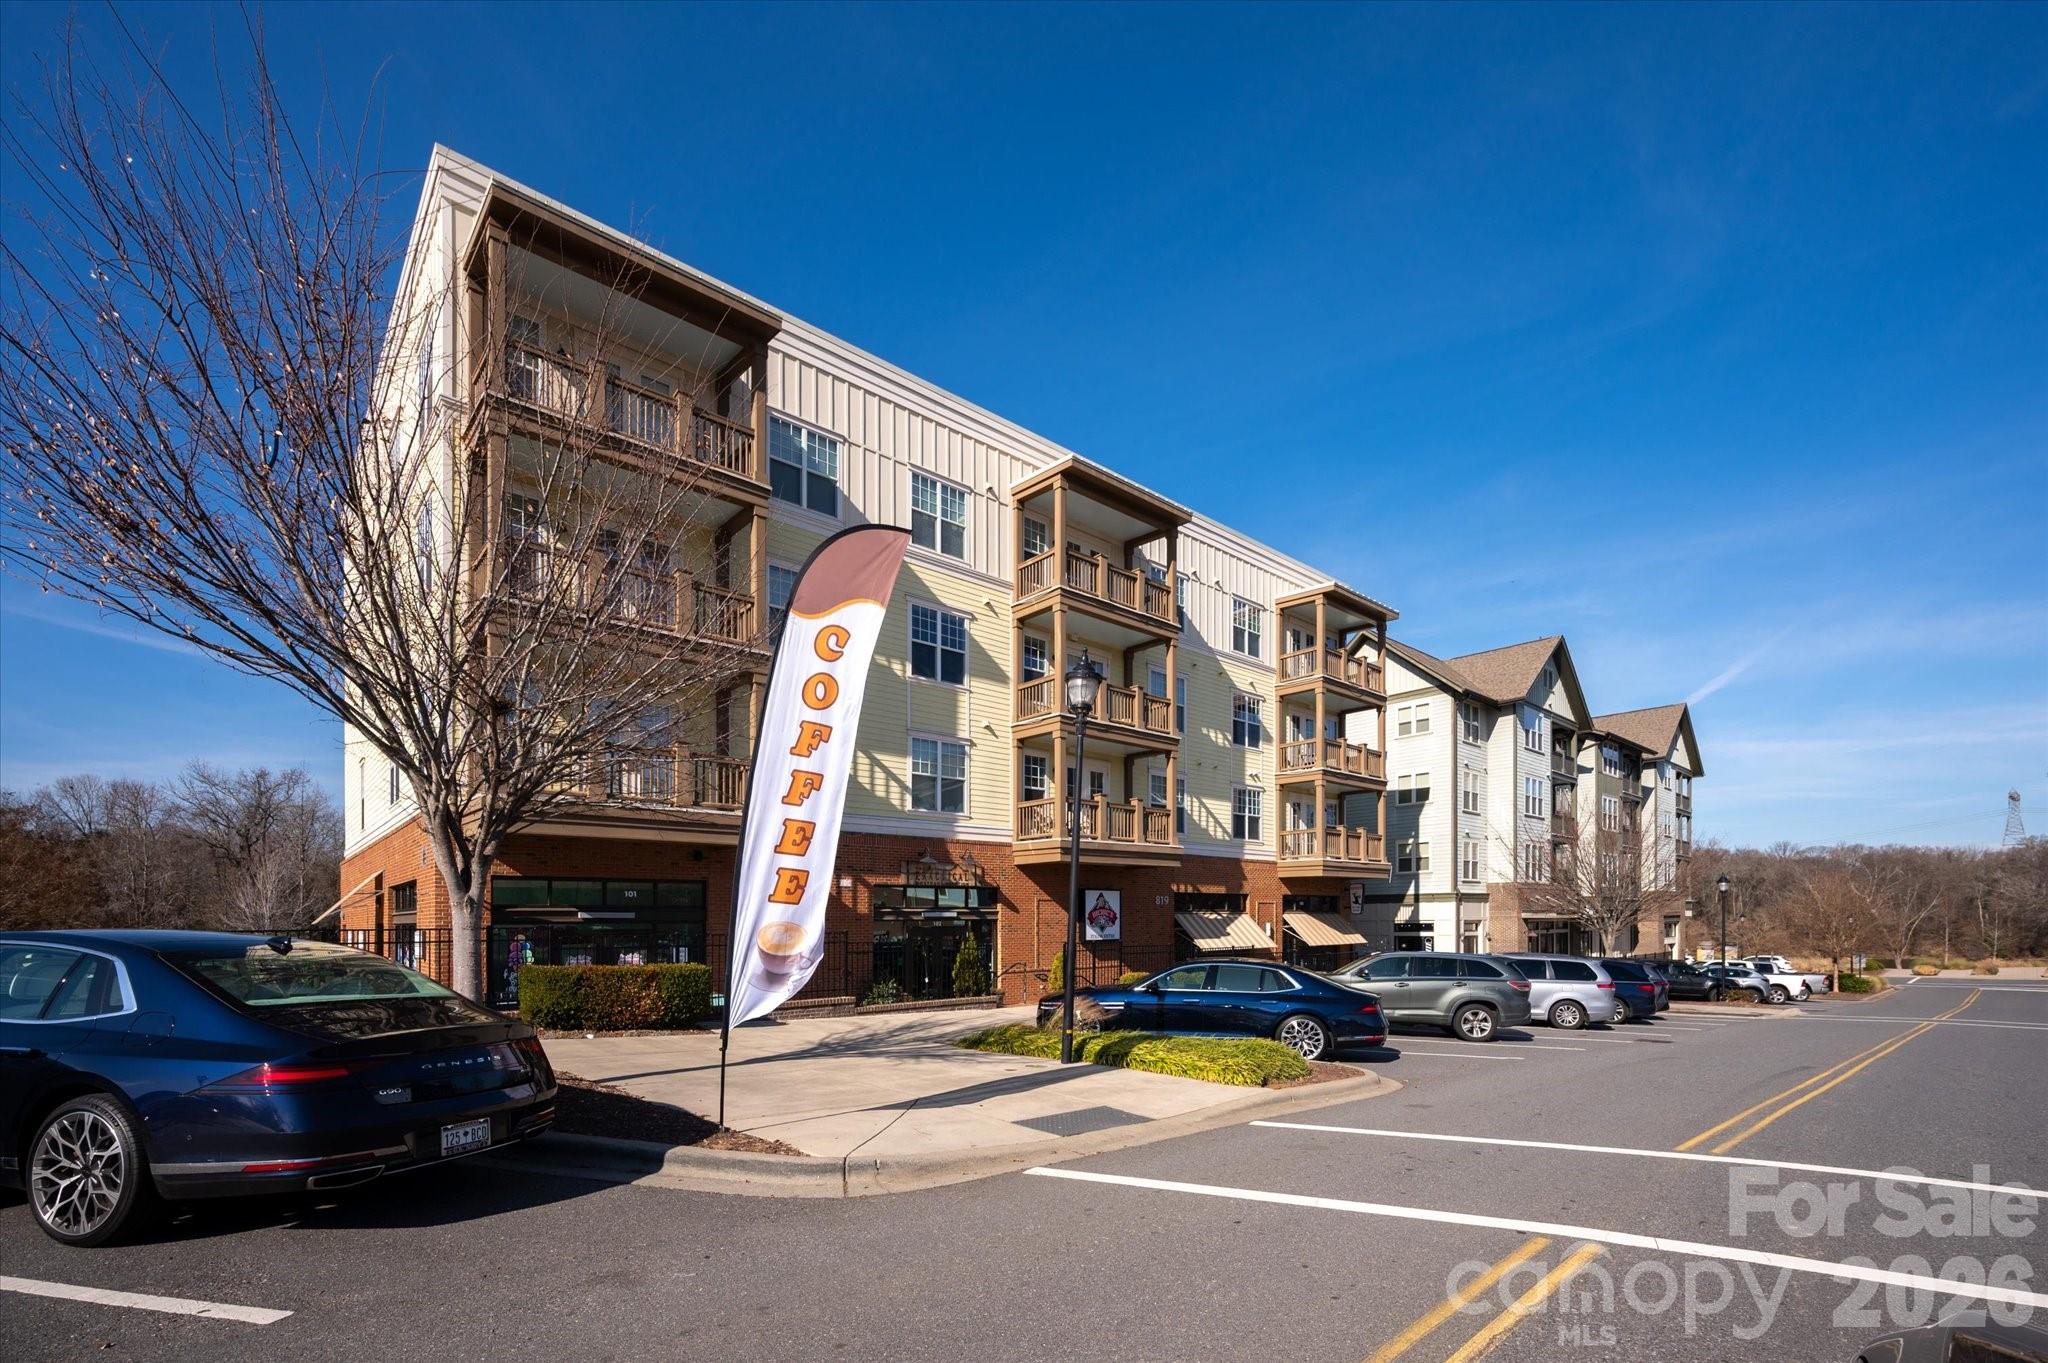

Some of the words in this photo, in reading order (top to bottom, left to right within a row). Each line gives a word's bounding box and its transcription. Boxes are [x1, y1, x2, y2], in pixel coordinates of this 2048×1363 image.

[769, 624, 851, 905] COFFEE
[624, 890, 637, 898] 101
[1155, 895, 1169, 905] 819
[421, 1055, 501, 1069] GENESIS
[378, 1087, 402, 1095] G90
[445, 1131, 460, 1147] 125
